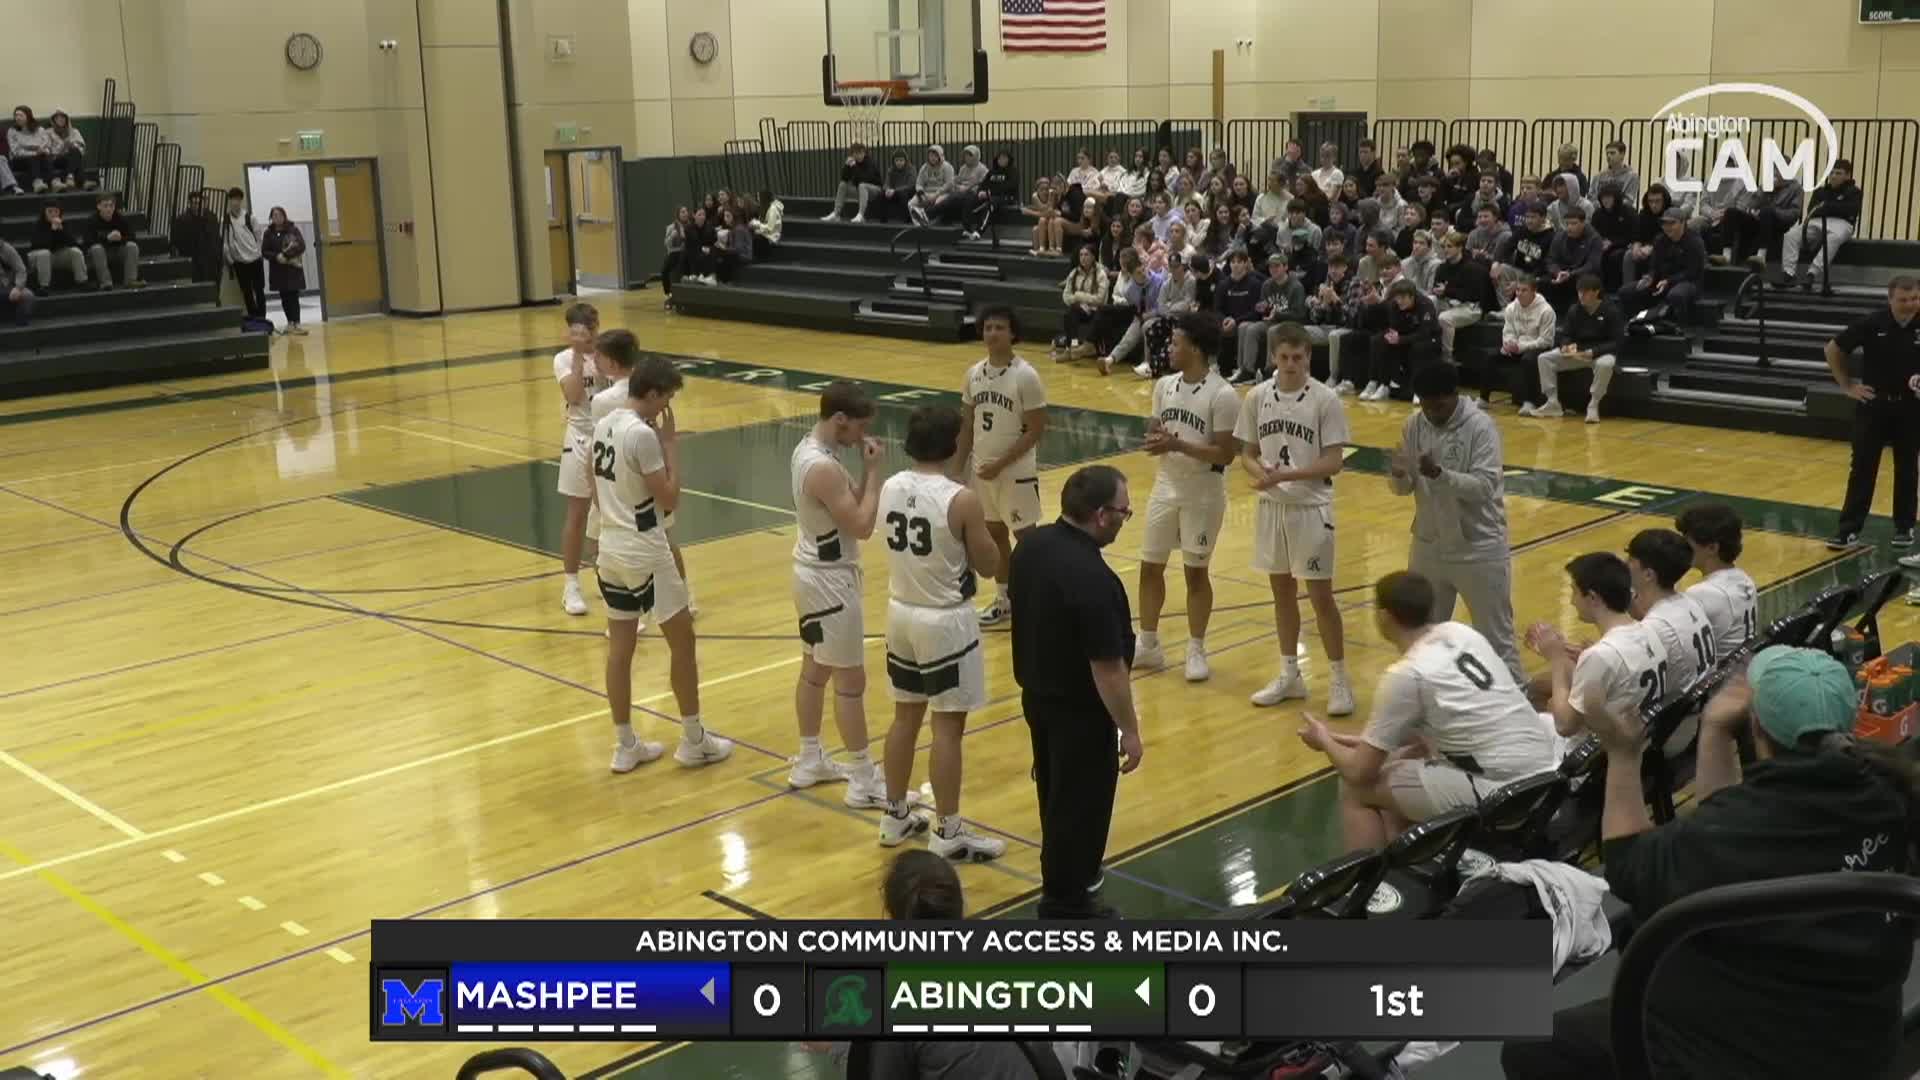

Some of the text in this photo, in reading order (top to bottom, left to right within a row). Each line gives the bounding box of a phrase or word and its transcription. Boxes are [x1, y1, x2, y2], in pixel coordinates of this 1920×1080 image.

[982, 411, 994, 432] 5
[1180, 408, 1206, 435] WAVE
[1285, 419, 1315, 445] WAVE
[594, 440, 616, 482] 22
[1280, 444, 1291, 467] 4
[886, 510, 933, 557] 33
[1692, 624, 1715, 675] 10
